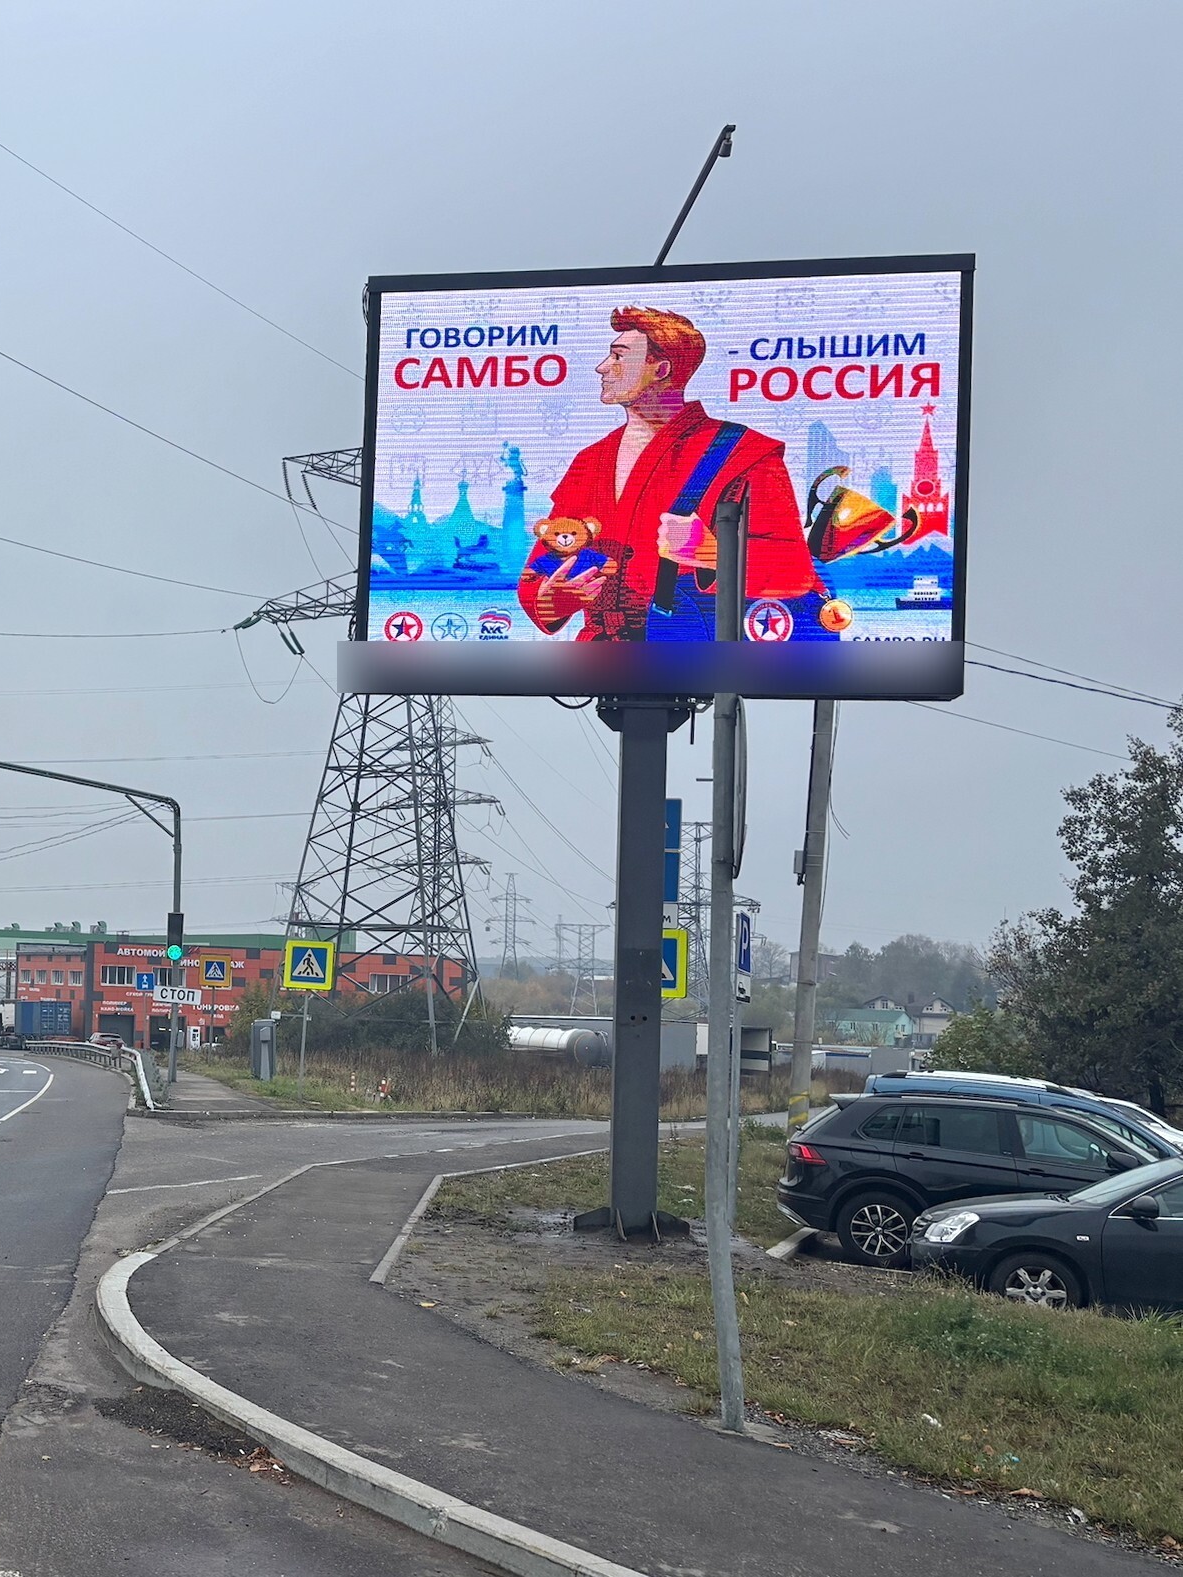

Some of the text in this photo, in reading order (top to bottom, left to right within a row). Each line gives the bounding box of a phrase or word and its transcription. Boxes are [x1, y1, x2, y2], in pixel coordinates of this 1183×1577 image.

[405, 325, 558, 349] ГОВОРИМ
[749, 333, 926, 360] СЛЫШИМ
[394, 354, 567, 389] САМБО
[729, 362, 941, 402] РОССИЯ
[117, 947, 167, 958] АВТОМОЙ
[160, 988, 195, 1002] СТОП
